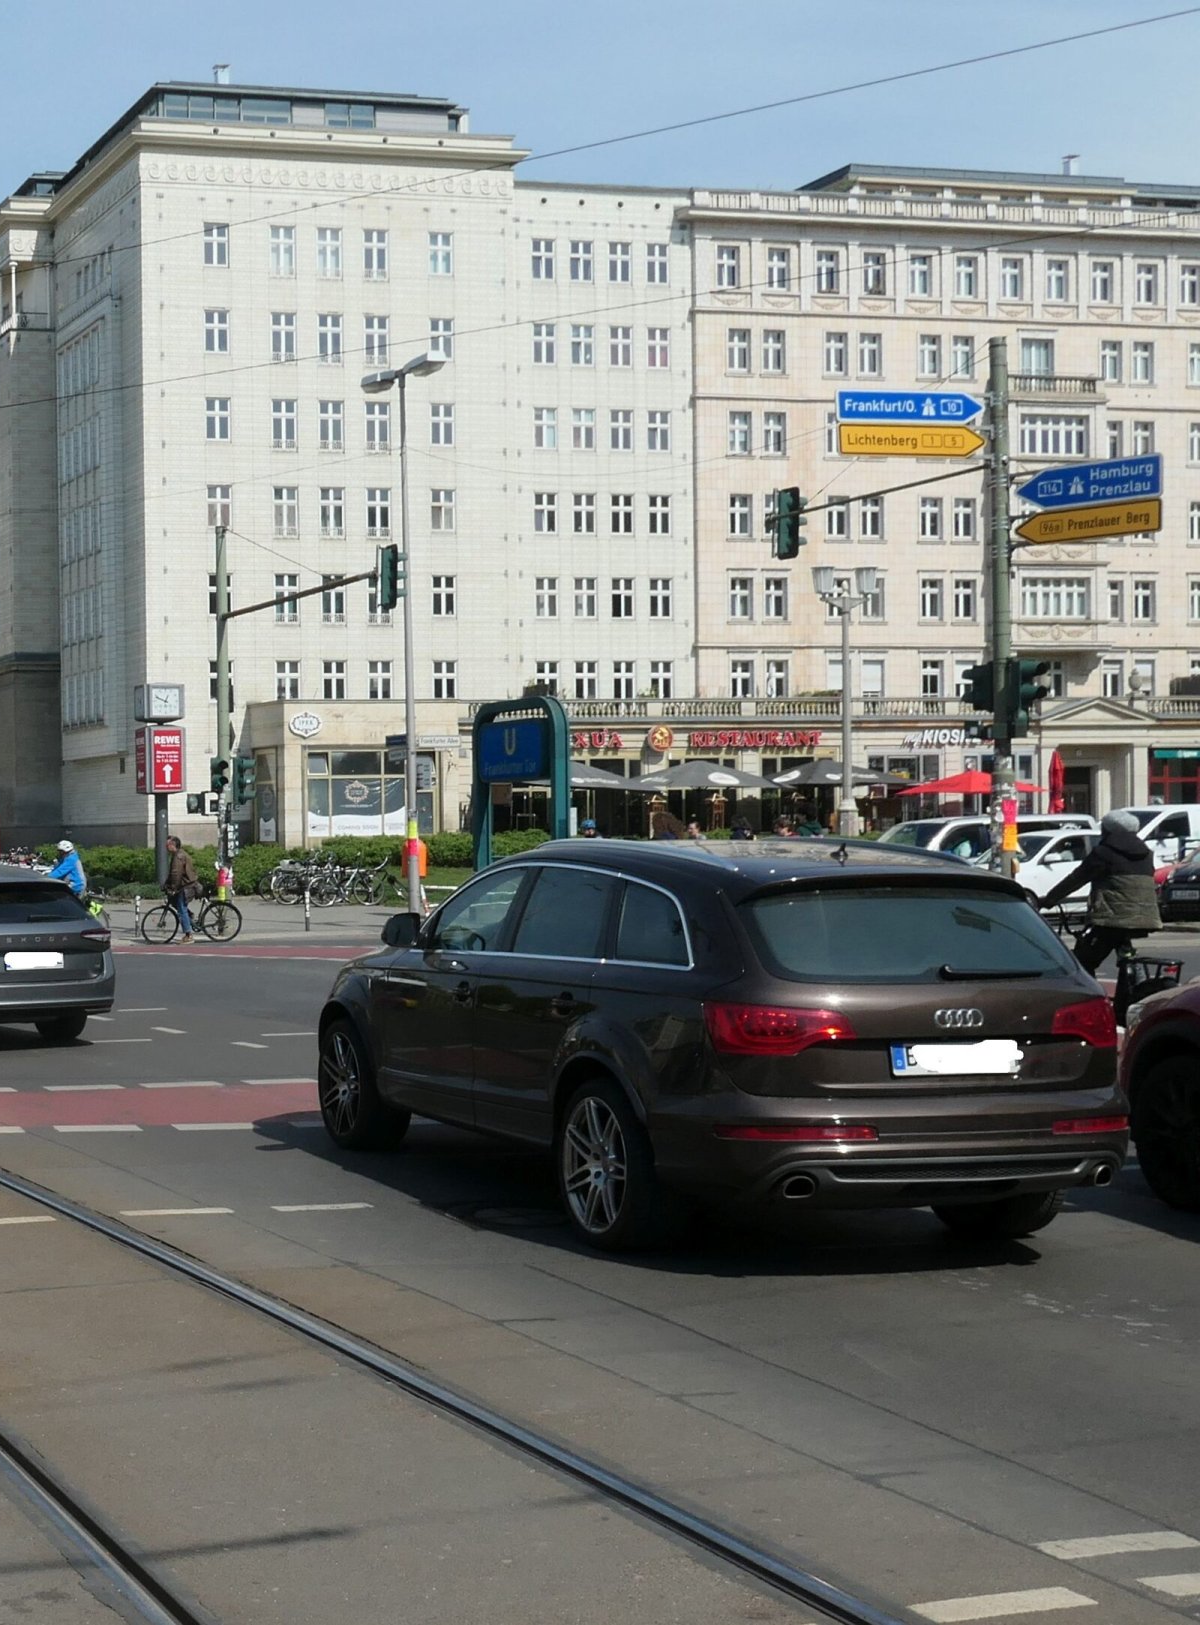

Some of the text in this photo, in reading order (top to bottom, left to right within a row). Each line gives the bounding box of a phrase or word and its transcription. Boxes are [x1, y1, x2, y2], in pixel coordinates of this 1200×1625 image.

[844, 398, 957, 413] Frankfurt/O. 10
[847, 434, 918, 449] Lichtenberg
[950, 437, 957, 446] 5
[1089, 463, 1154, 480] Hamburg
[1042, 480, 1151, 498] 114 Prenzlau
[1067, 515, 1122, 531] Prenzlauer
[1126, 511, 1150, 526] Berg
[154, 735, 180, 745] REWE
[504, 727, 516, 756] U
[690, 730, 822, 747] RESTAURANT
